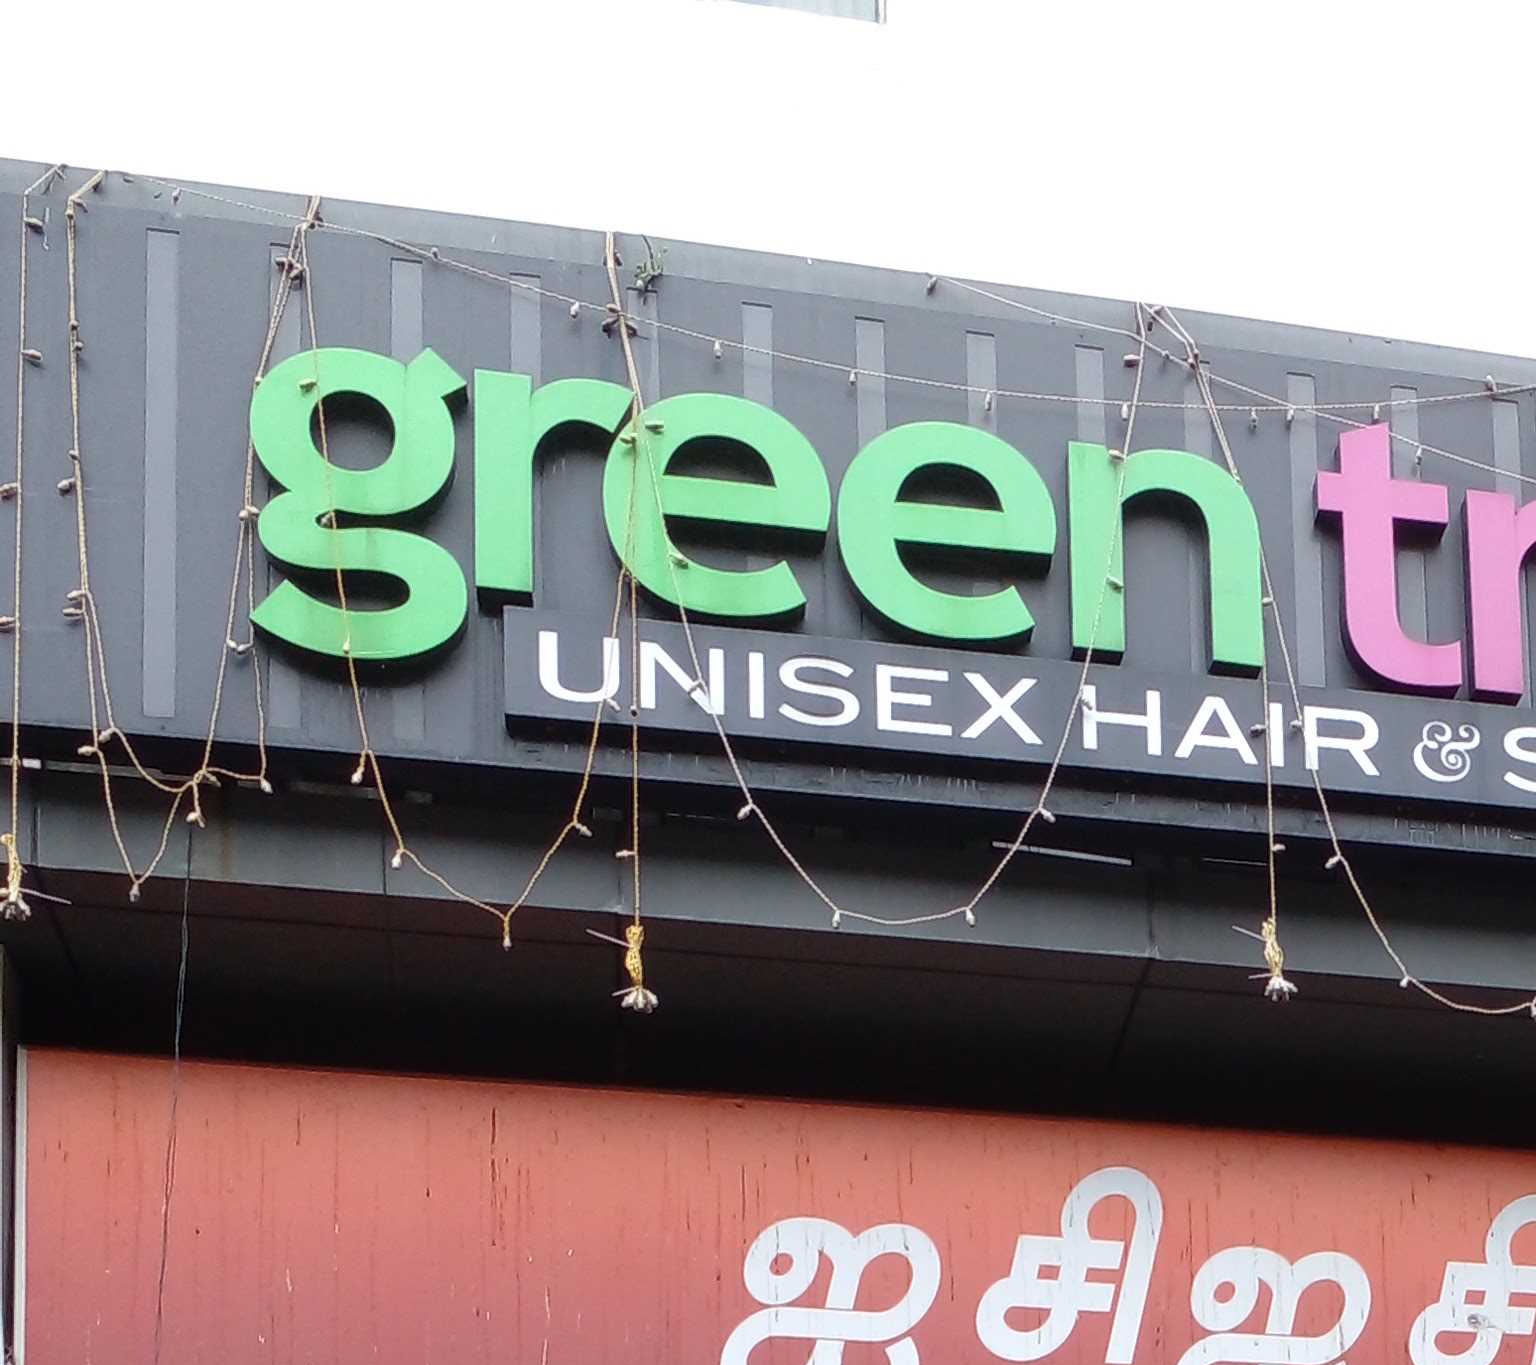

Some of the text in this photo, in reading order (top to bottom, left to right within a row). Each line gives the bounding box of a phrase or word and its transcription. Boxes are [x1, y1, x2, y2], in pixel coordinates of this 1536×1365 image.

[250, 347, 1263, 671] green
[537, 630, 1044, 746] UNISEX
[1081, 685, 1381, 777] HAIR
[1413, 721, 1481, 783] &
